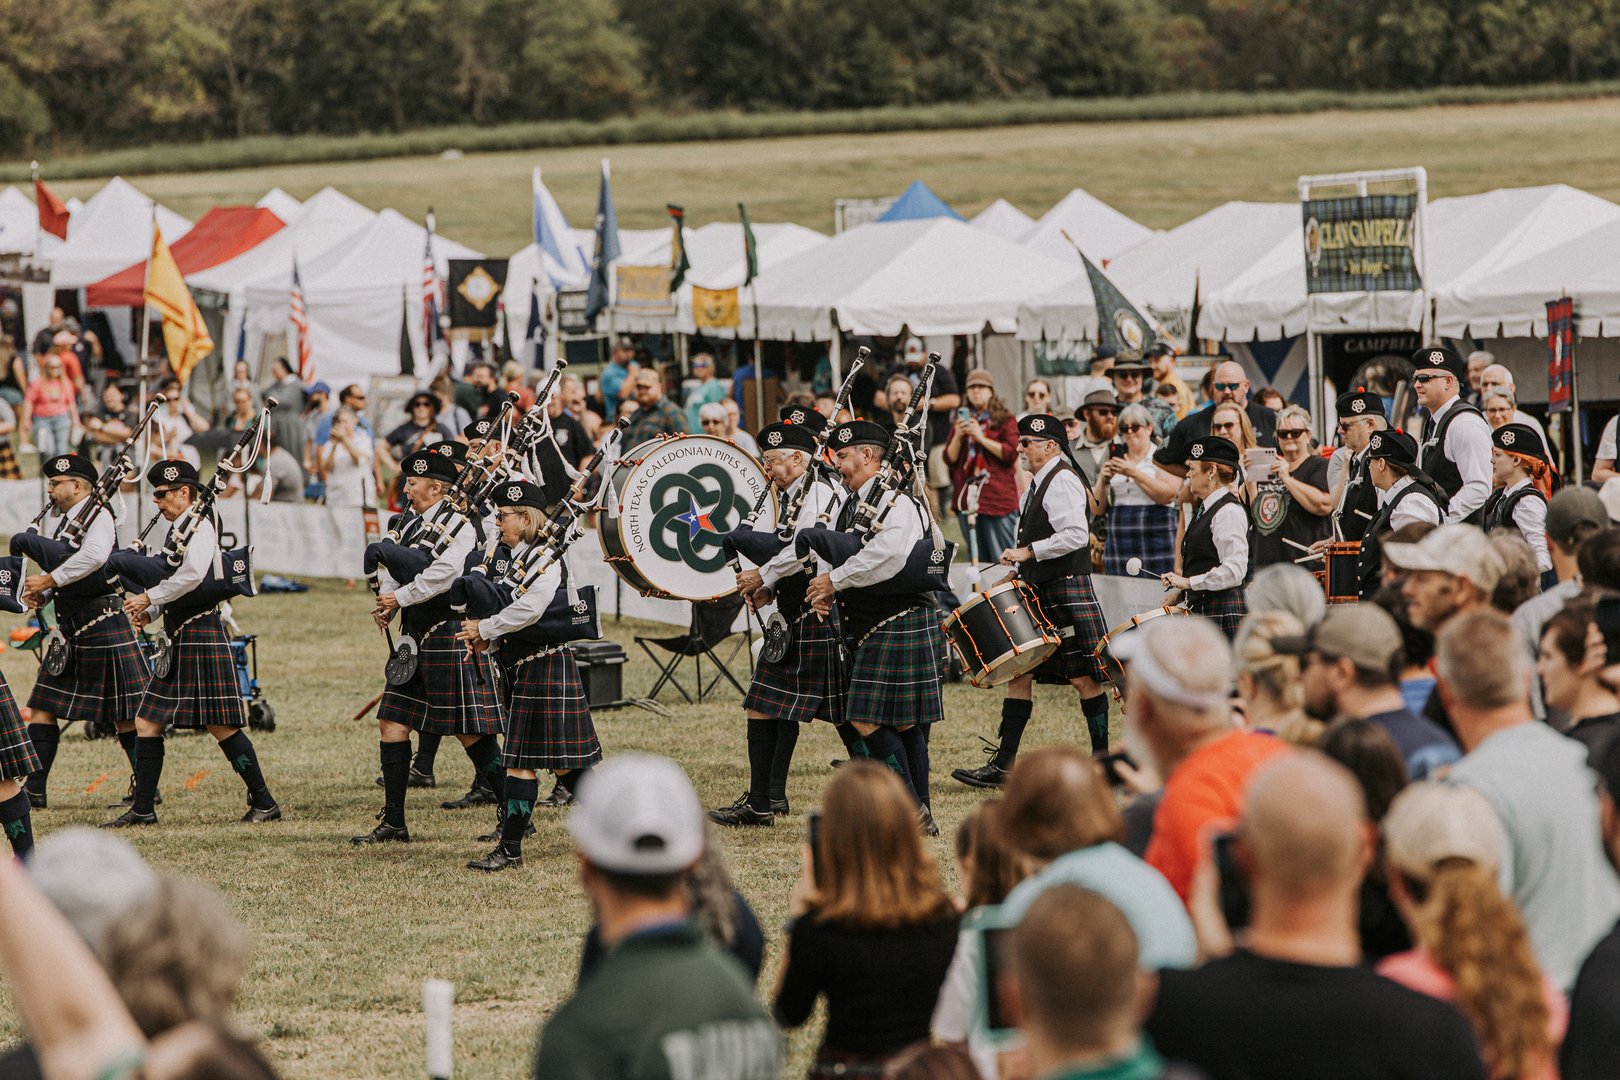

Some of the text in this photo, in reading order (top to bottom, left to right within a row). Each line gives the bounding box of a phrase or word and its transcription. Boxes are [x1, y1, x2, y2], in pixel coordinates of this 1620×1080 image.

[630, 446, 766, 553] NORTH TEXAS CALEDONIAN PIPES & DRUS
